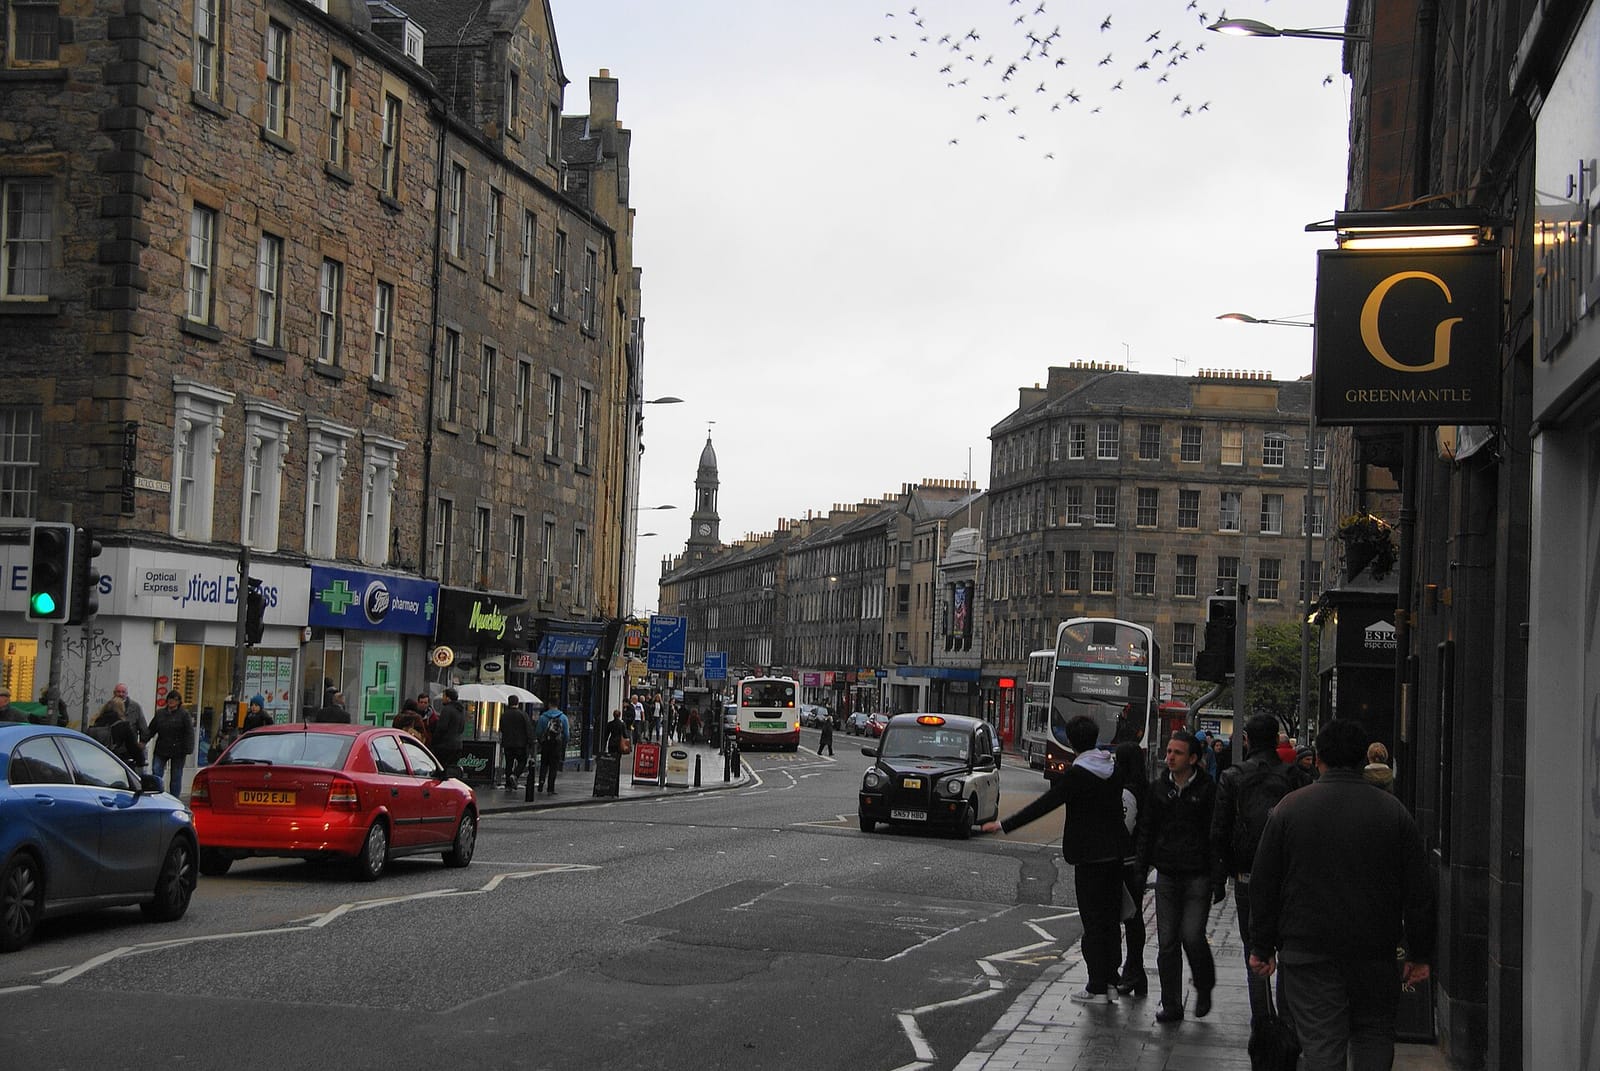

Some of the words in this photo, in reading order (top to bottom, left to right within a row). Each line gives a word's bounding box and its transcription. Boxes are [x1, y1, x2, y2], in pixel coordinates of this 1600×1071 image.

[1359, 270, 1464, 373] G
[1345, 388, 1472, 403] GREENMANTLE
[145, 571, 177, 583] Optical
[143, 582, 179, 594] Express
[172, 573, 222, 608] ptical
[225, 576, 278, 608] Exss
[391, 596, 420, 615] pharmacy
[1365, 631, 1398, 641] ESPC
[1114, 675, 1122, 687] 3
[243, 792, 270, 802] DV02
[271, 793, 292, 804] EJL
